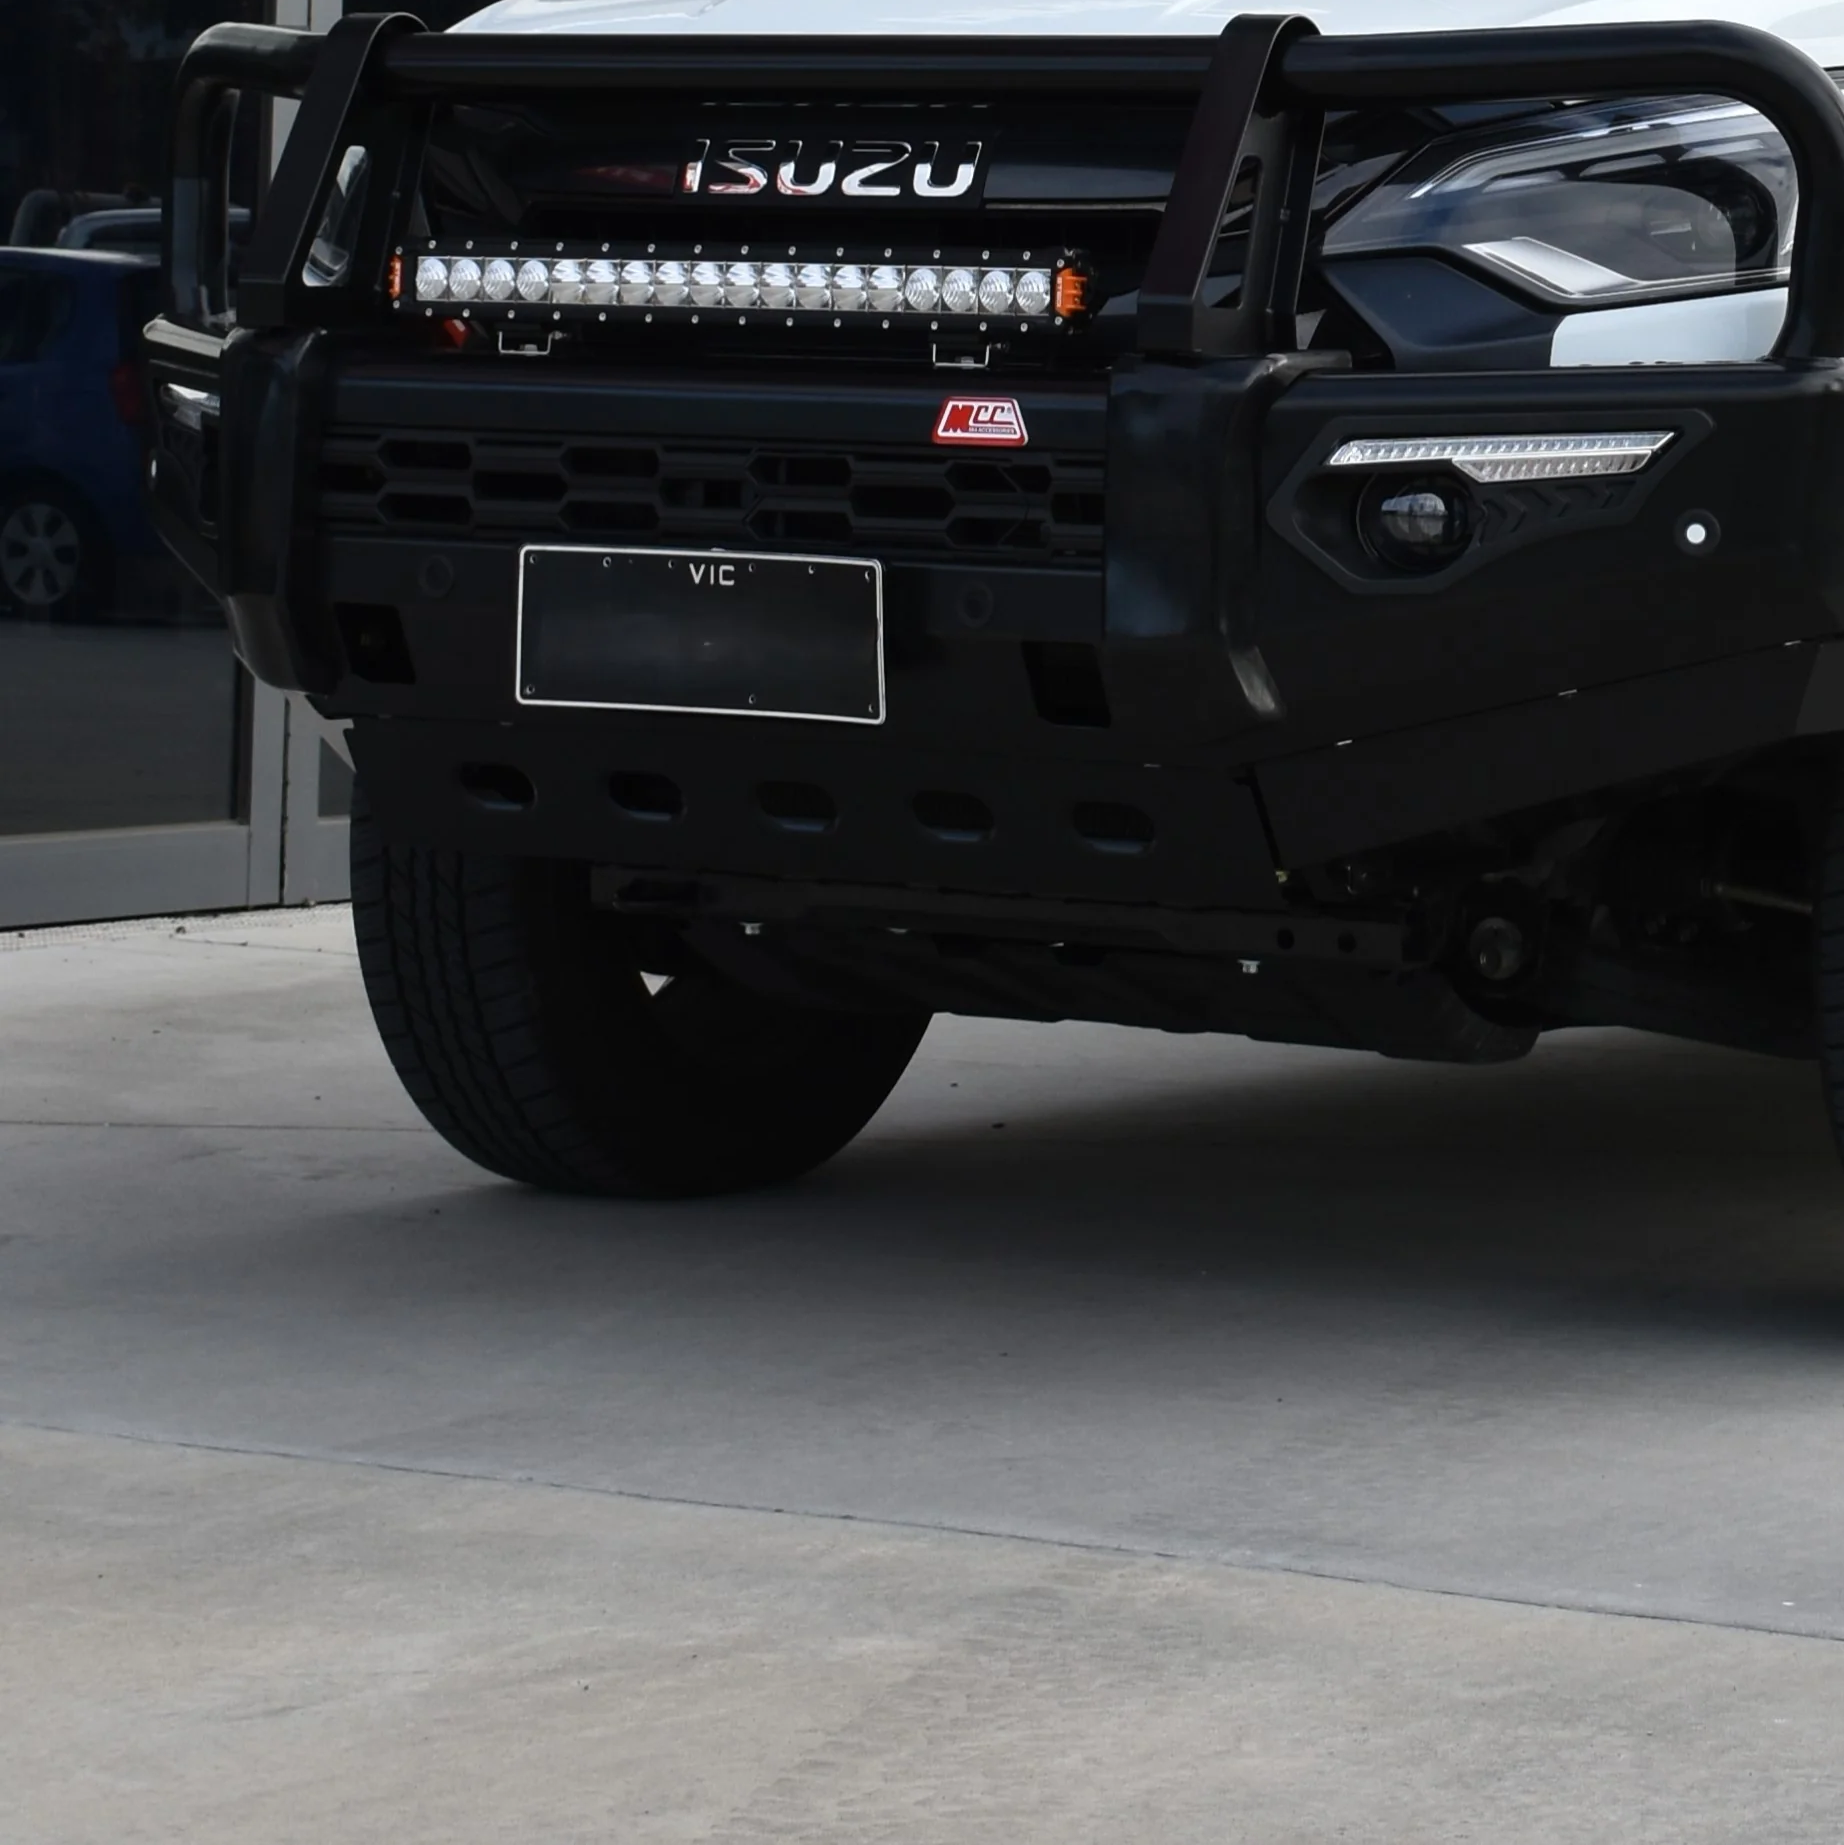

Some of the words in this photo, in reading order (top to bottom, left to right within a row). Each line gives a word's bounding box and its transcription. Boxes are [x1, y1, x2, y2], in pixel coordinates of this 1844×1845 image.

[683, 139, 982, 196] ISUZU
[942, 404, 1014, 433] MCC
[689, 563, 735, 586] VIC
